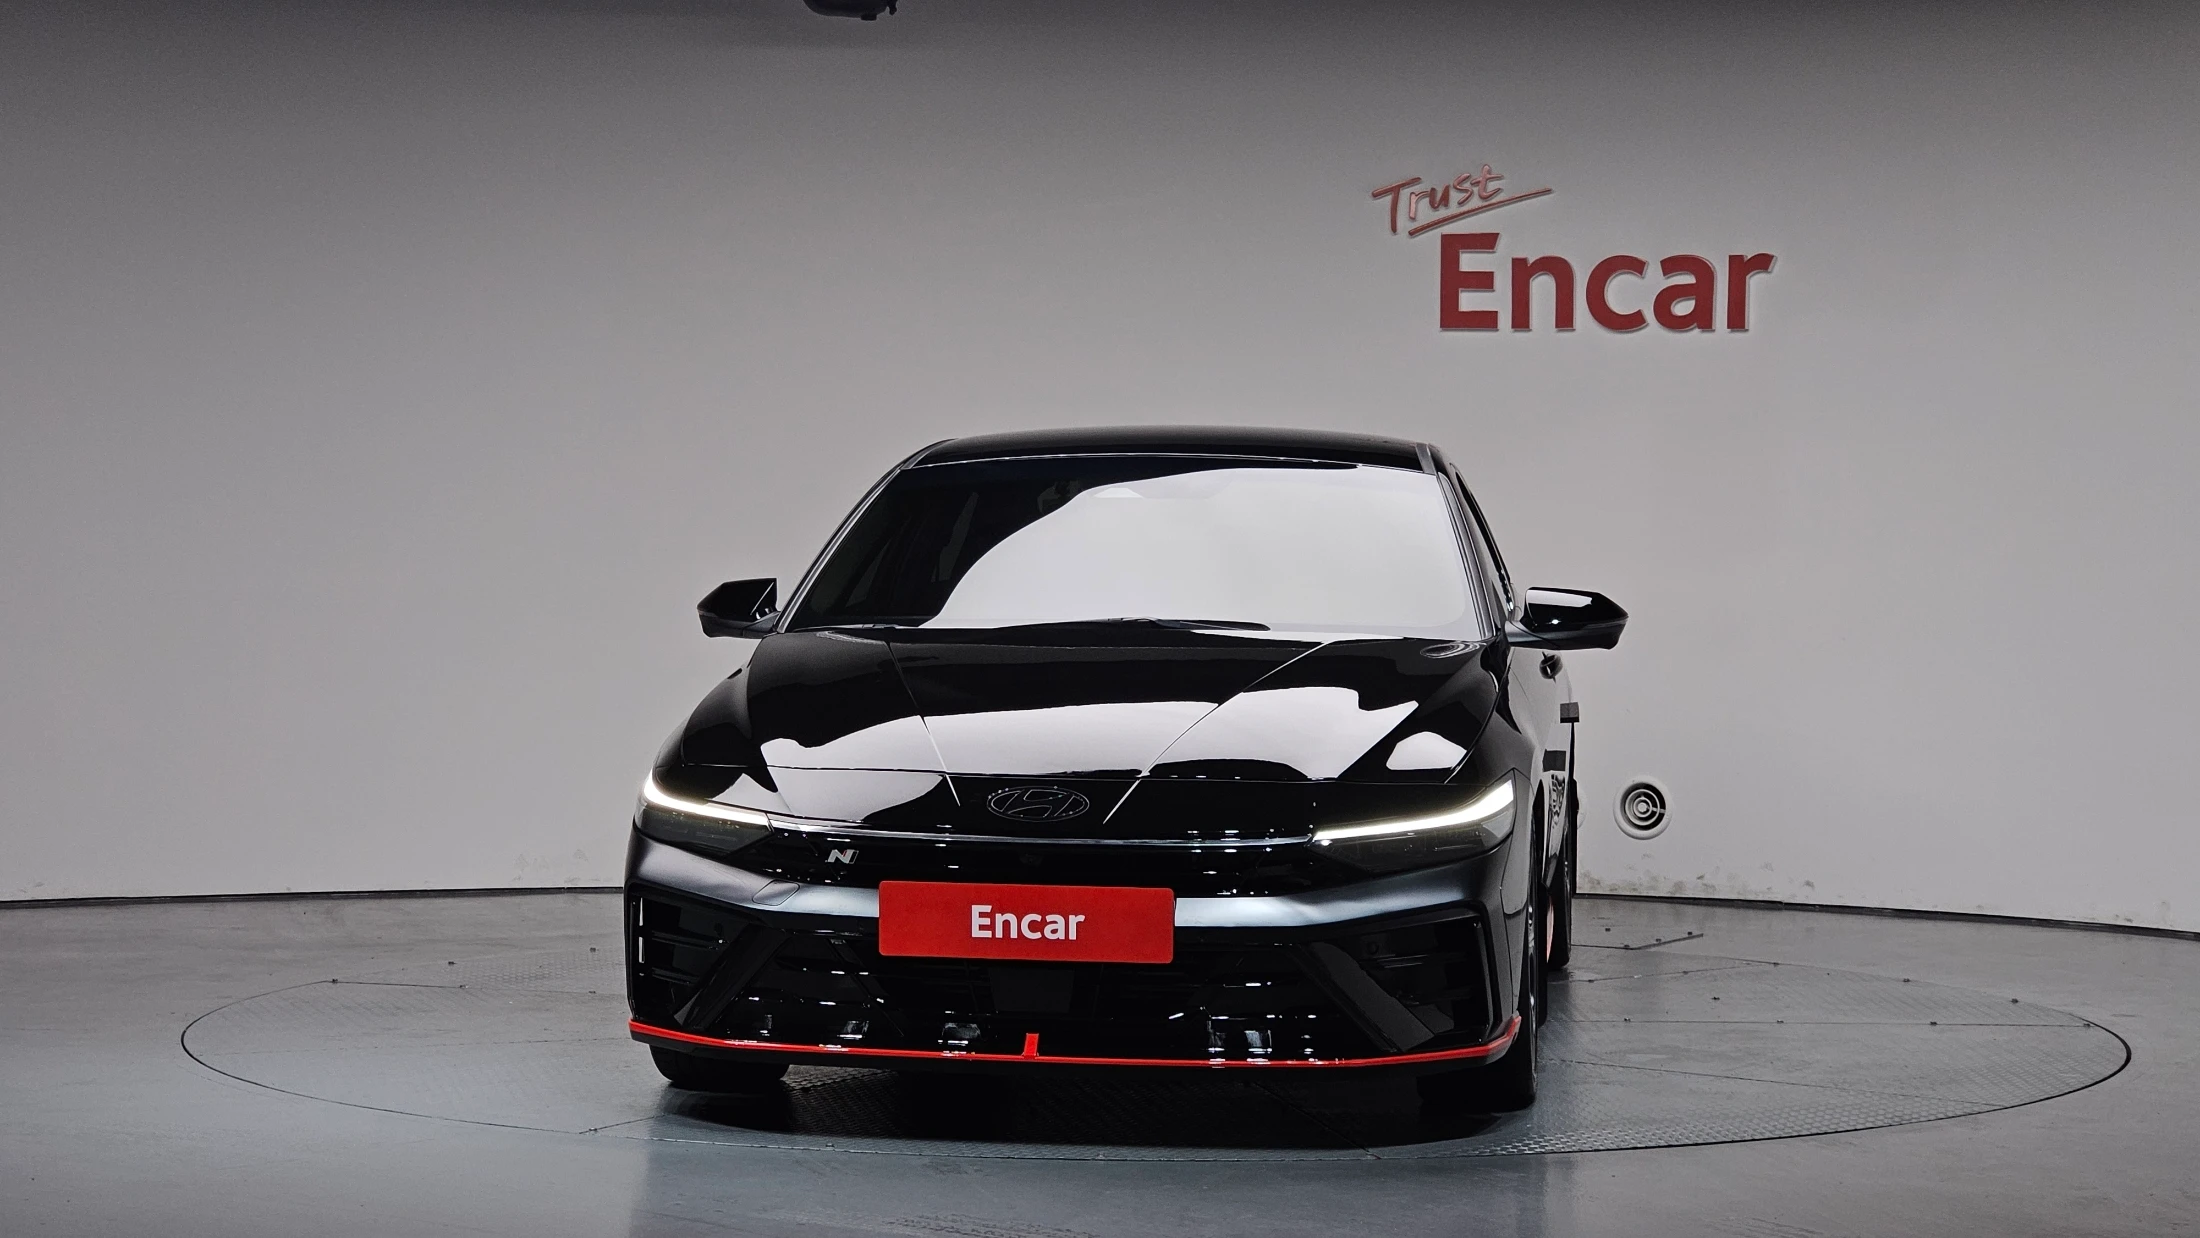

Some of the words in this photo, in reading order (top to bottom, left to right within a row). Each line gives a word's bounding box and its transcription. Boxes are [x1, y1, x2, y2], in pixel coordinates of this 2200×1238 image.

[1371, 163, 1504, 235] Trust
[1439, 231, 1777, 332] Encar
[970, 904, 1086, 941] Encar
